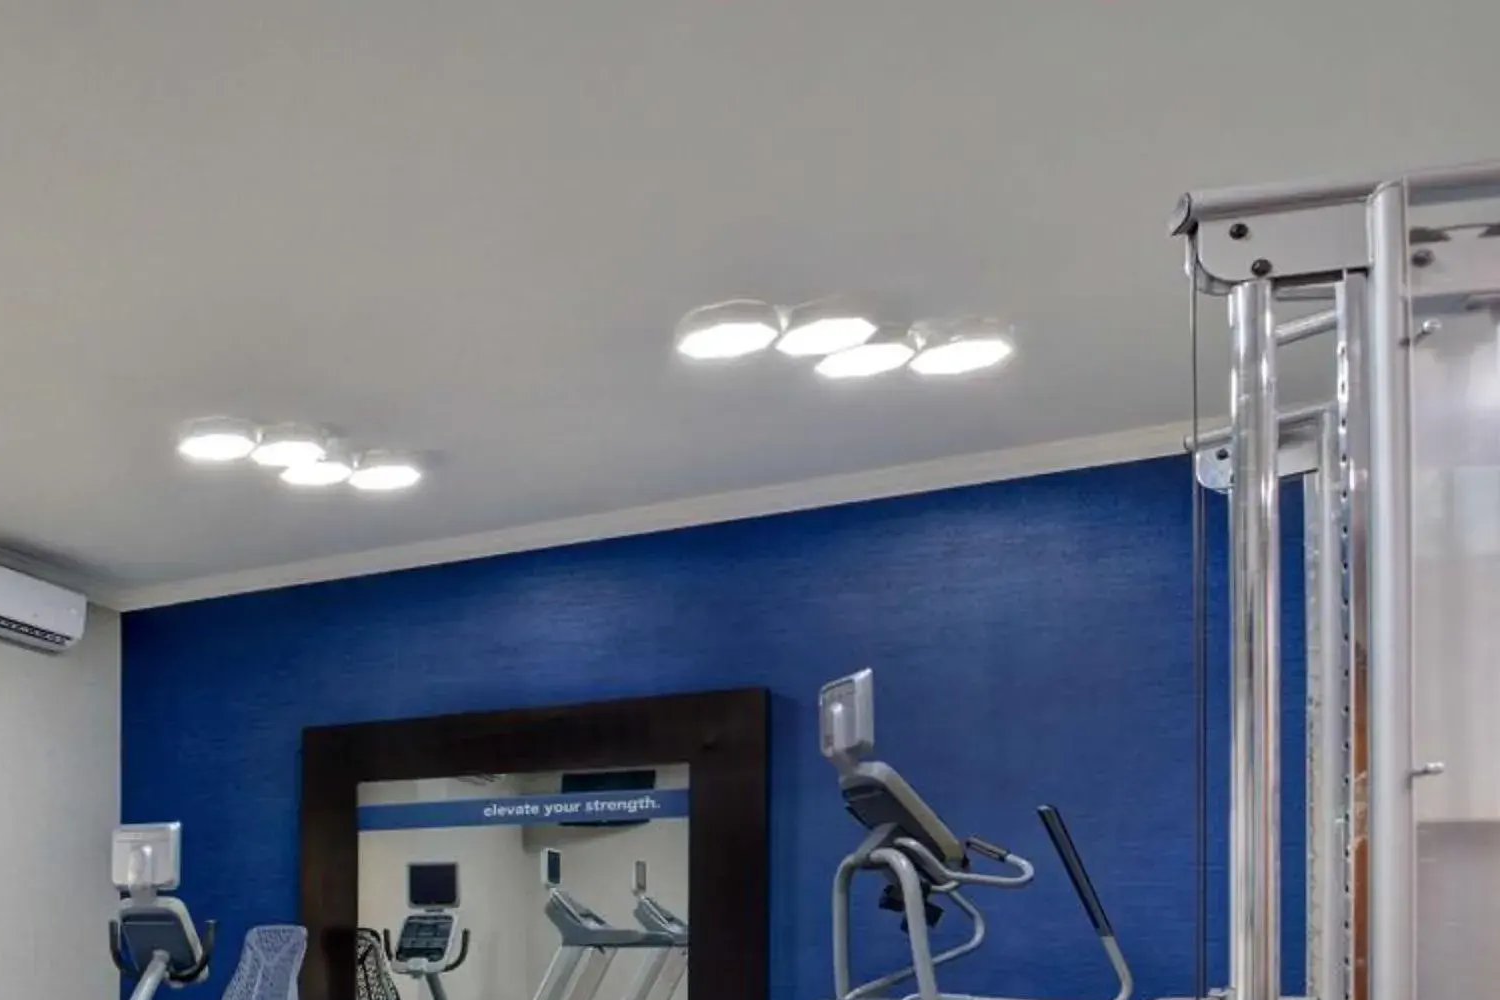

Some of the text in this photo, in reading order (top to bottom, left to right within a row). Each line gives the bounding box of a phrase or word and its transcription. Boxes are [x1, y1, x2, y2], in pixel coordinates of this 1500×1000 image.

[483, 796, 660, 817] elevate your strength.
